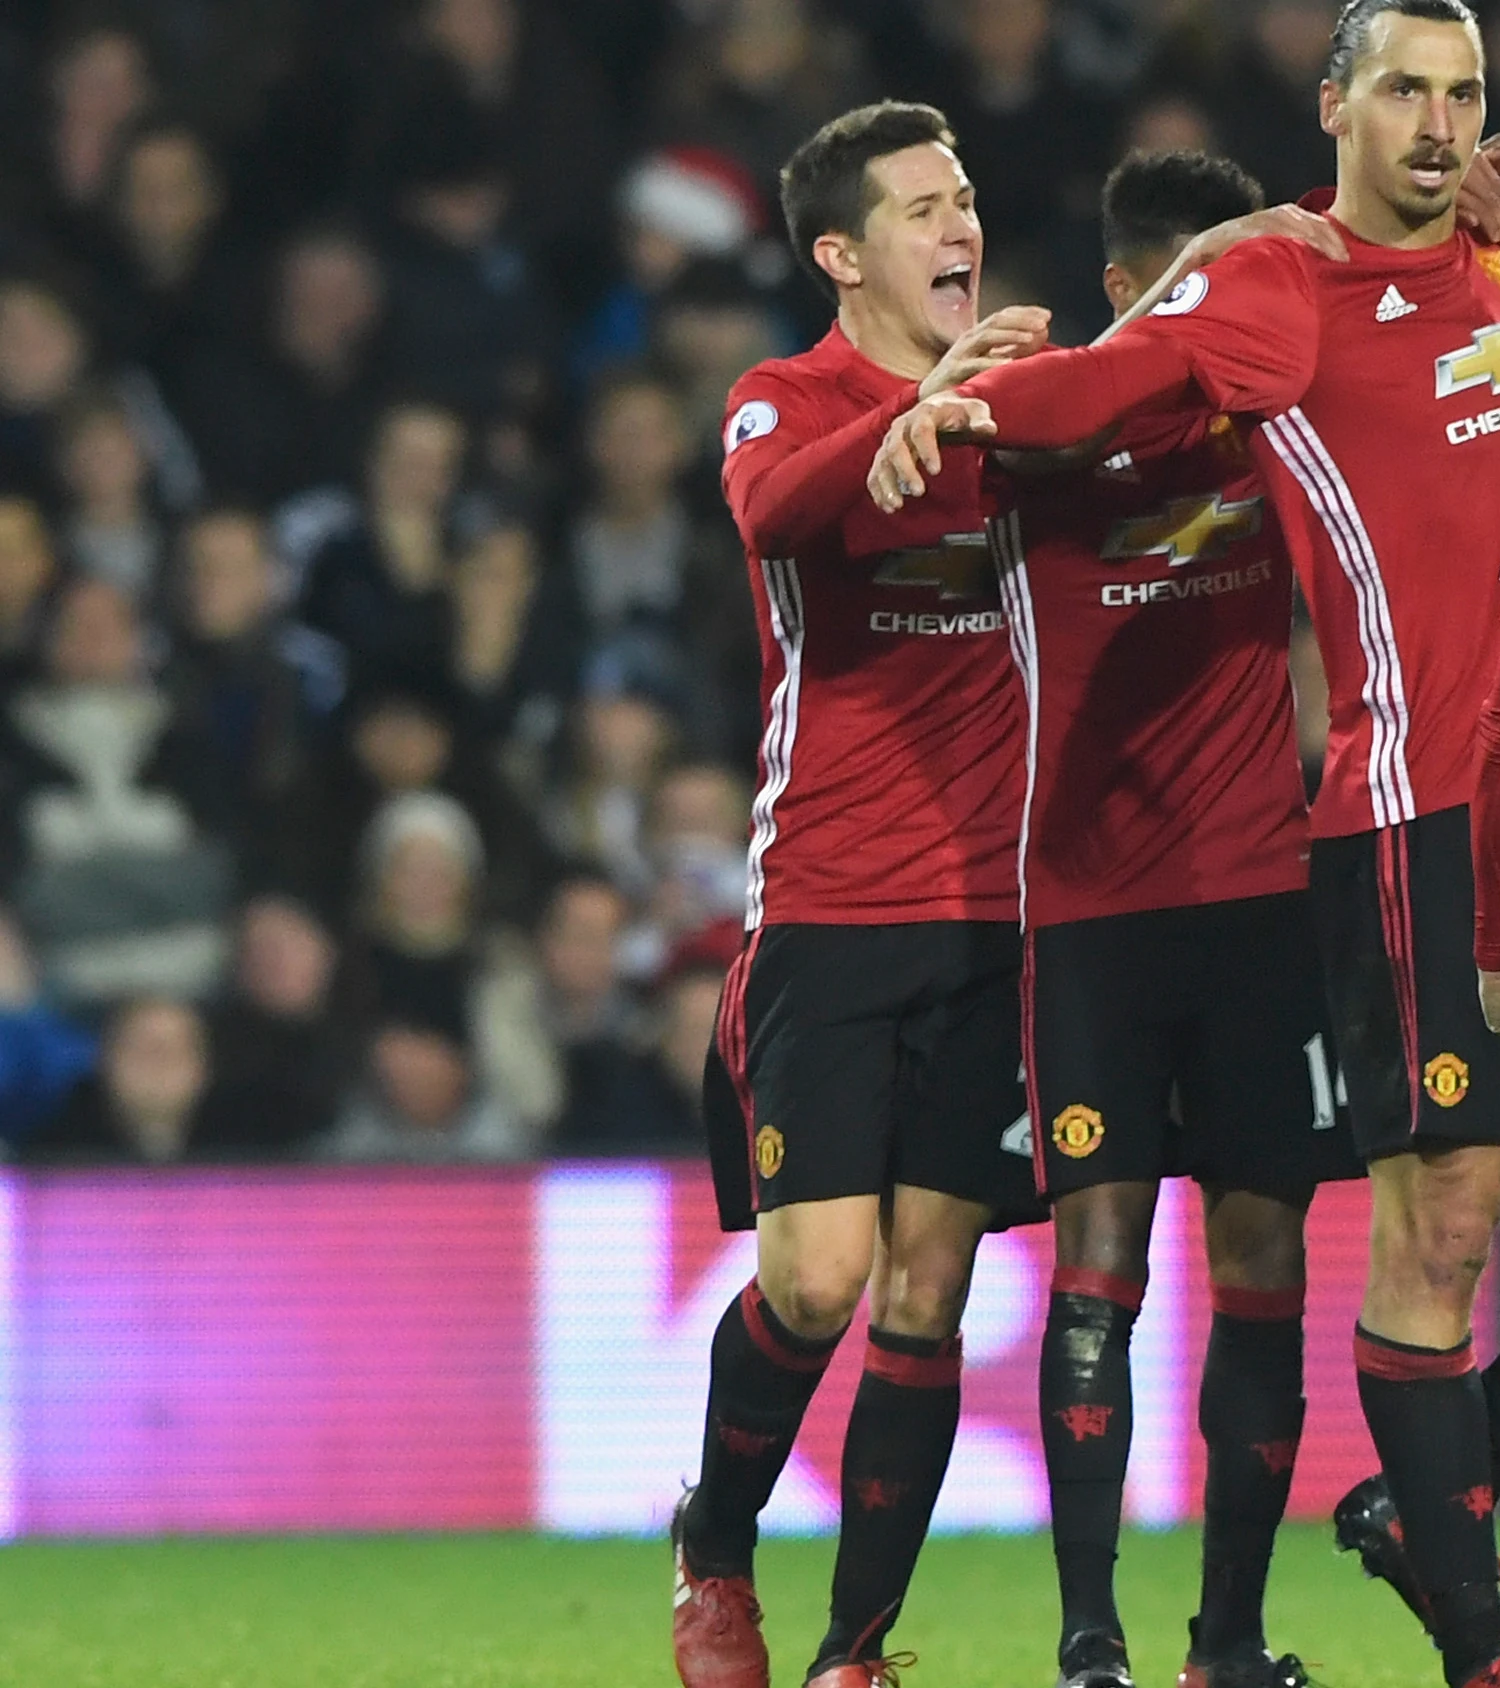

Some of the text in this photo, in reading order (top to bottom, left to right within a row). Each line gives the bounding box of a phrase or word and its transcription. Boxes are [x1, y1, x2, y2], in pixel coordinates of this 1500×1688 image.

[1101, 559, 1272, 606] CHEVROLET
[870, 611, 1005, 634] CHEVROL
[1303, 1032, 1349, 1130] 1
